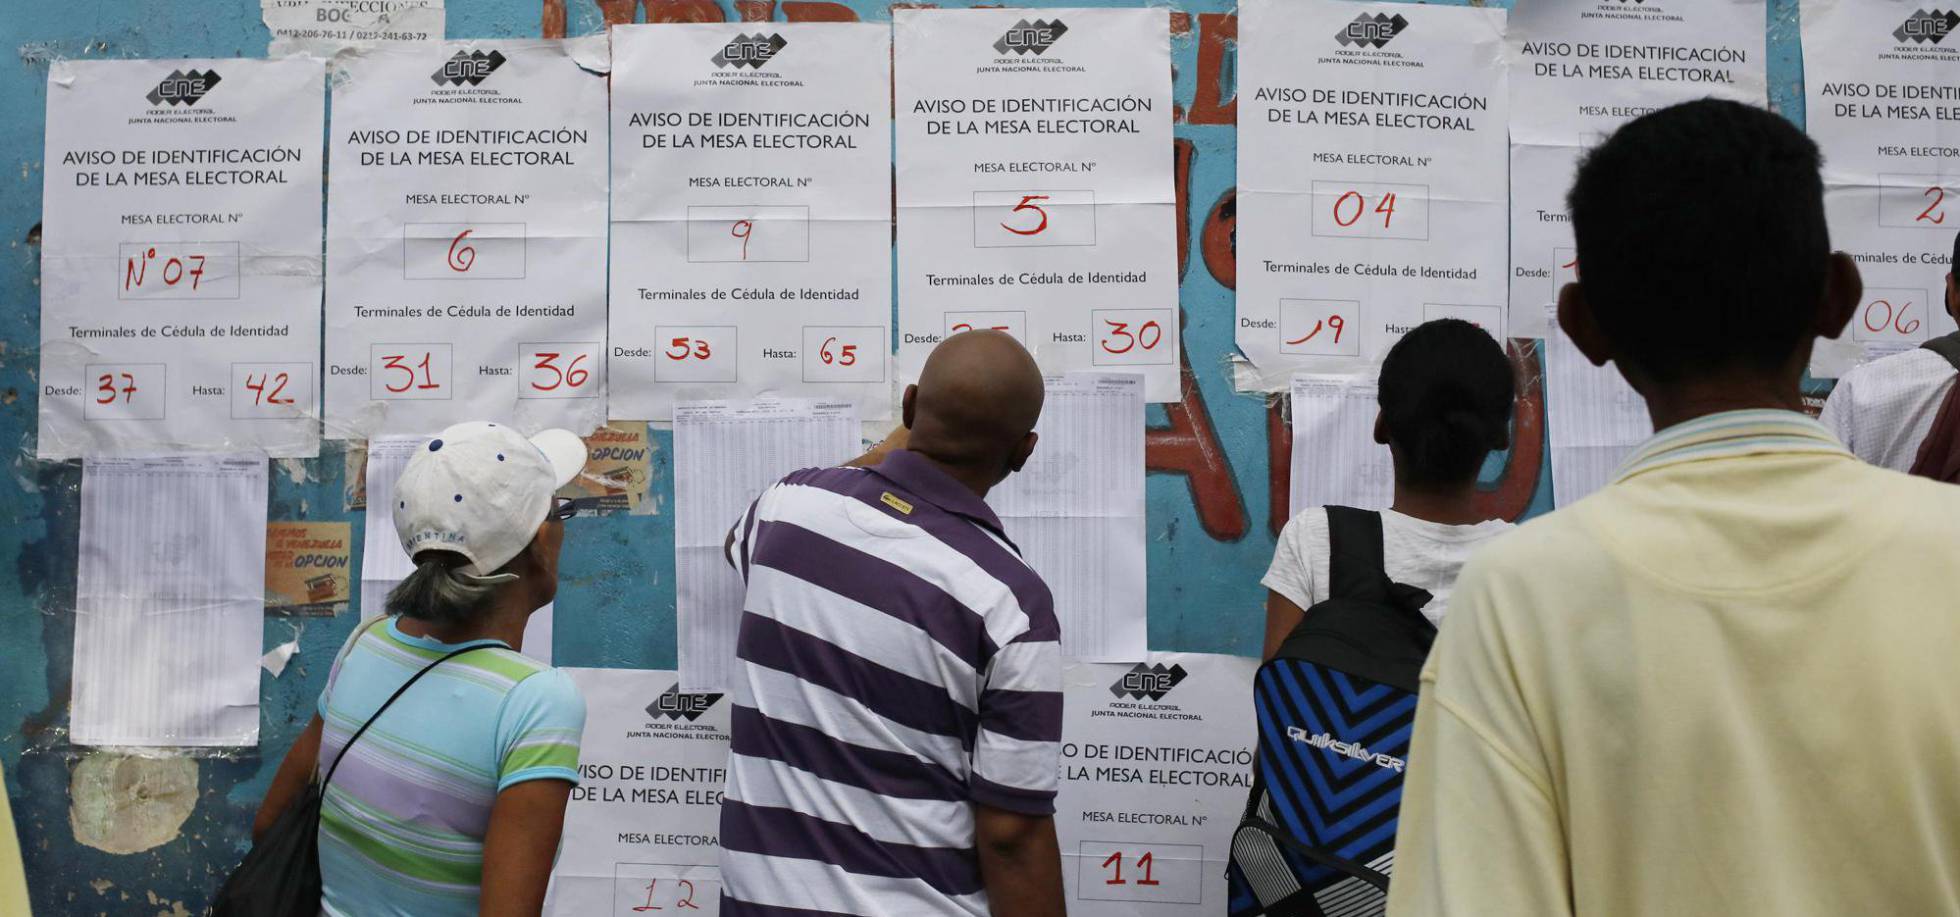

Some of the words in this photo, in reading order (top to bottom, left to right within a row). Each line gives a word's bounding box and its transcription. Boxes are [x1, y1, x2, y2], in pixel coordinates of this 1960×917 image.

[1346, 21, 1395, 40] CNE
[1904, 17, 1949, 36] CNE
[1005, 27, 1054, 47] CNE
[723, 42, 773, 61] CNE
[1521, 41, 1571, 56] AVISO
[1576, 43, 1599, 58] DE
[1604, 43, 1745, 63] IDENTIFICACIÓN
[443, 58, 491, 78] CNE
[976, 65, 1000, 74] JUNTA
[1001, 64, 1041, 72] NACIONAL
[1534, 62, 1557, 77] DE
[1562, 63, 1583, 77] LA
[1588, 64, 1633, 79] MESA
[1638, 65, 1735, 84] ELECTORAL
[158, 78, 207, 98] CNE
[1821, 82, 1870, 97] AVISO
[1875, 84, 1897, 98] DE
[912, 99, 966, 113] AVISO
[972, 99, 996, 113] DE
[1001, 94, 1151, 112] IDENTIFICACIÓN
[1254, 87, 1306, 102] AVISO
[1312, 88, 1336, 104] DE
[1341, 90, 1486, 110] IDENTIFICACIÓN
[628, 112, 682, 126] AVISO
[688, 112, 712, 127] DE
[718, 110, 869, 127] IDENTIFICACIÓN
[1268, 108, 1291, 122] DE
[1297, 109, 1318, 124] LA
[1324, 110, 1370, 126] MESA
[1375, 112, 1474, 131] ELECTORAL
[1834, 103, 1856, 117] DE
[1861, 103, 1882, 118] LA
[1887, 104, 1930, 119] MESA
[347, 129, 400, 144] AVISO
[406, 129, 430, 144] DE
[436, 125, 587, 144] IDENTIFICACIÓN
[927, 120, 950, 134] DE
[956, 120, 979, 134] LA
[984, 119, 1031, 134] MESA
[1036, 118, 1140, 133] ELECTORAL
[642, 133, 666, 148] DE
[672, 133, 694, 148] LA
[700, 133, 747, 148] MESA
[752, 133, 856, 148] ELECTORAL
[62, 150, 115, 165] AVISO
[122, 150, 146, 164] DE
[152, 144, 300, 164] IDENTIFICACIÓN
[360, 151, 384, 166] DE
[390, 151, 412, 165] LA
[418, 150, 464, 165] MESA
[470, 150, 574, 165] ELECTORAL
[1312, 152, 1343, 164] MESA
[1346, 153, 1414, 166] ELECTORAL
[974, 162, 1006, 173] MESA
[1008, 161, 1078, 172] ELECTORAL
[75, 171, 99, 186] DE
[105, 171, 128, 186] LA
[133, 171, 180, 186] MESA
[185, 169, 287, 185] ELECTORAL
[688, 176, 720, 187] MESA
[724, 176, 794, 187] ELECTORAL
[405, 193, 437, 206] MESA
[440, 193, 511, 204] ELECTORAL
[1916, 186, 1945, 225] 2
[120, 214, 152, 224] MESA
[156, 213, 224, 224] ELECTORAL
[1000, 195, 1050, 236] 5
[1334, 191, 1396, 228] 04
[731, 220, 752, 261] 9
[448, 230, 475, 272] 6
[163, 255, 206, 290] 07
[925, 273, 994, 286] Terminales
[998, 273, 1014, 285] de
[1018, 272, 1063, 284] Cédula
[1067, 271, 1083, 283] de
[1088, 270, 1146, 283] Identidad
[1262, 260, 1330, 274] Terminales
[1334, 262, 1349, 274] de
[1353, 263, 1397, 276] Cédula
[1401, 264, 1416, 277] de
[1420, 265, 1476, 279] Identidad
[1516, 266, 1551, 278] Desde:
[637, 287, 706, 300] Terminales
[710, 287, 726, 299] de
[730, 287, 775, 300] Cédula
[779, 287, 795, 299] de
[799, 287, 859, 300] Identidad
[353, 305, 422, 317] Terminales
[426, 305, 442, 317] de
[446, 304, 491, 317] Cédula
[495, 305, 511, 316] de
[515, 304, 574, 316] Identidad
[1864, 300, 1920, 334] 06
[68, 325, 136, 338] Terminales
[140, 325, 156, 337] de
[160, 324, 205, 337] Cédula
[209, 324, 225, 336] de
[229, 324, 288, 336] Identidad
[1241, 318, 1277, 329] Desde:
[904, 333, 941, 345] Desde:
[1052, 332, 1086, 343] Hasta:
[1102, 320, 1162, 354] 30
[614, 346, 651, 358] Desde:
[665, 336, 711, 361] 53
[763, 348, 796, 360] Hasta:
[820, 337, 858, 367] 65
[331, 364, 367, 376] Desde:
[381, 352, 440, 393] 31
[479, 364, 512, 376] Hasta:
[531, 352, 589, 392] 36
[45, 385, 82, 397] Desde:
[97, 373, 138, 404] 37
[192, 385, 225, 397] Hasta:
[246, 372, 295, 405] 42
[295, 554, 348, 568] OPCION
[1122, 672, 1172, 692] CNE
[658, 692, 708, 712] CNE
[1090, 709, 1115, 717] JUNTA
[1116, 710, 1158, 719] NACIONAL
[1158, 712, 1202, 720] ELECTORAL
[1084, 743, 1108, 759] DE
[619, 765, 644, 780] DE
[1067, 765, 1090, 780] LA
[1095, 766, 1143, 783] MESA
[1148, 769, 1251, 788] ELECTORAL
[602, 786, 625, 802] LA
[631, 788, 679, 804] MESA
[1082, 810, 1114, 822] MESA
[1117, 812, 1188, 825] ELECTORAL
[1102, 851, 1160, 886] 11
[633, 878, 699, 912] 12
